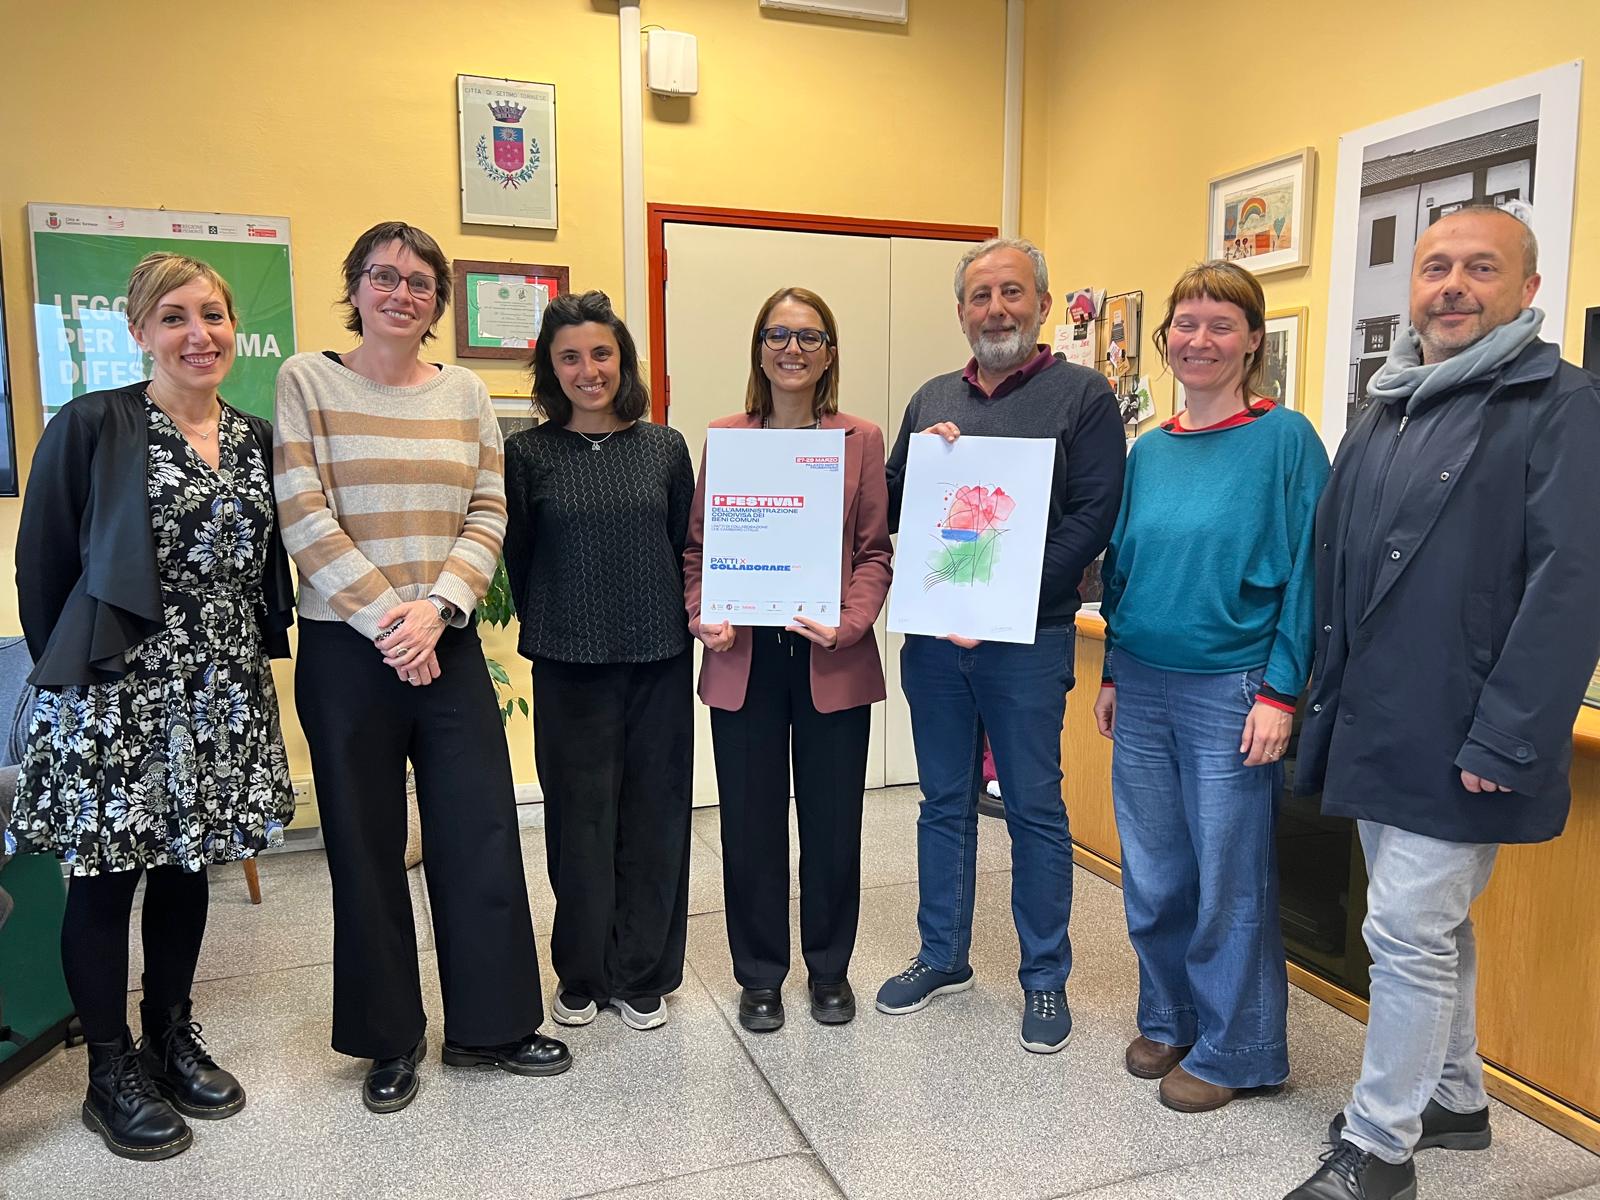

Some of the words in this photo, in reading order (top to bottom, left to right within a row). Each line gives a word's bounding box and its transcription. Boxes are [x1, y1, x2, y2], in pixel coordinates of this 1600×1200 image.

[57, 328, 116, 353] PER
[59, 360, 148, 385] DIFES
[726, 496, 803, 507] FESTIVAL
[710, 563, 791, 571] COLLABORARE
